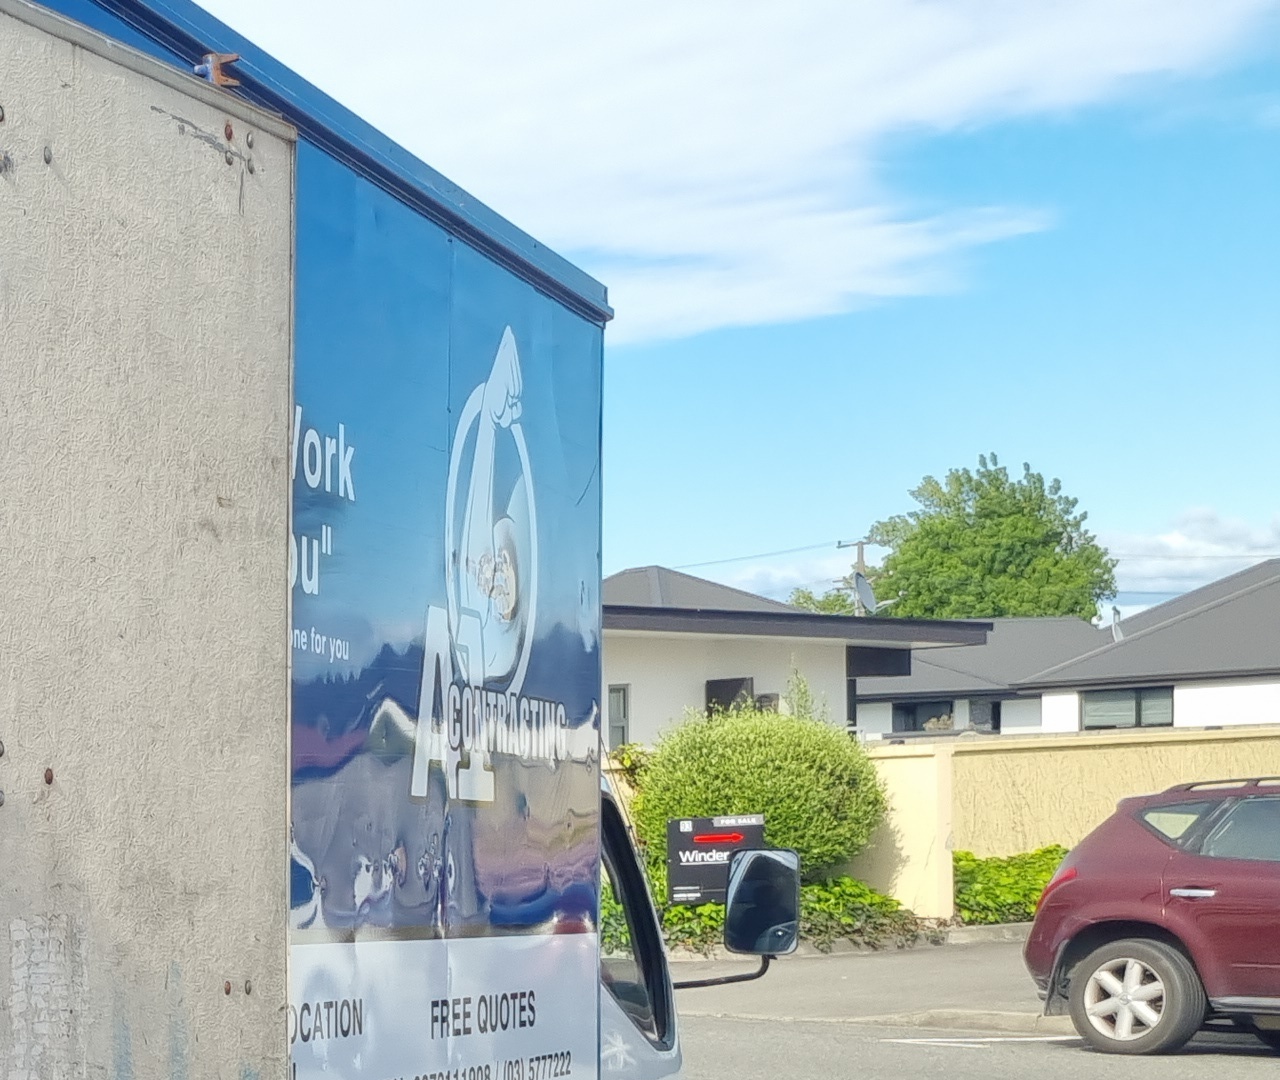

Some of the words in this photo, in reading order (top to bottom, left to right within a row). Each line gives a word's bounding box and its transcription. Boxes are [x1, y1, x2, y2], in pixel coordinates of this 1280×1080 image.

[290, 628, 307, 650] ne
[310, 626, 326, 655] for
[329, 637, 349, 664] you
[448, 683, 567, 761] CONTRACTING
[679, 849, 730, 863] Winder
[430, 996, 472, 1040] FREE
[477, 989, 536, 1033] QUOTES
